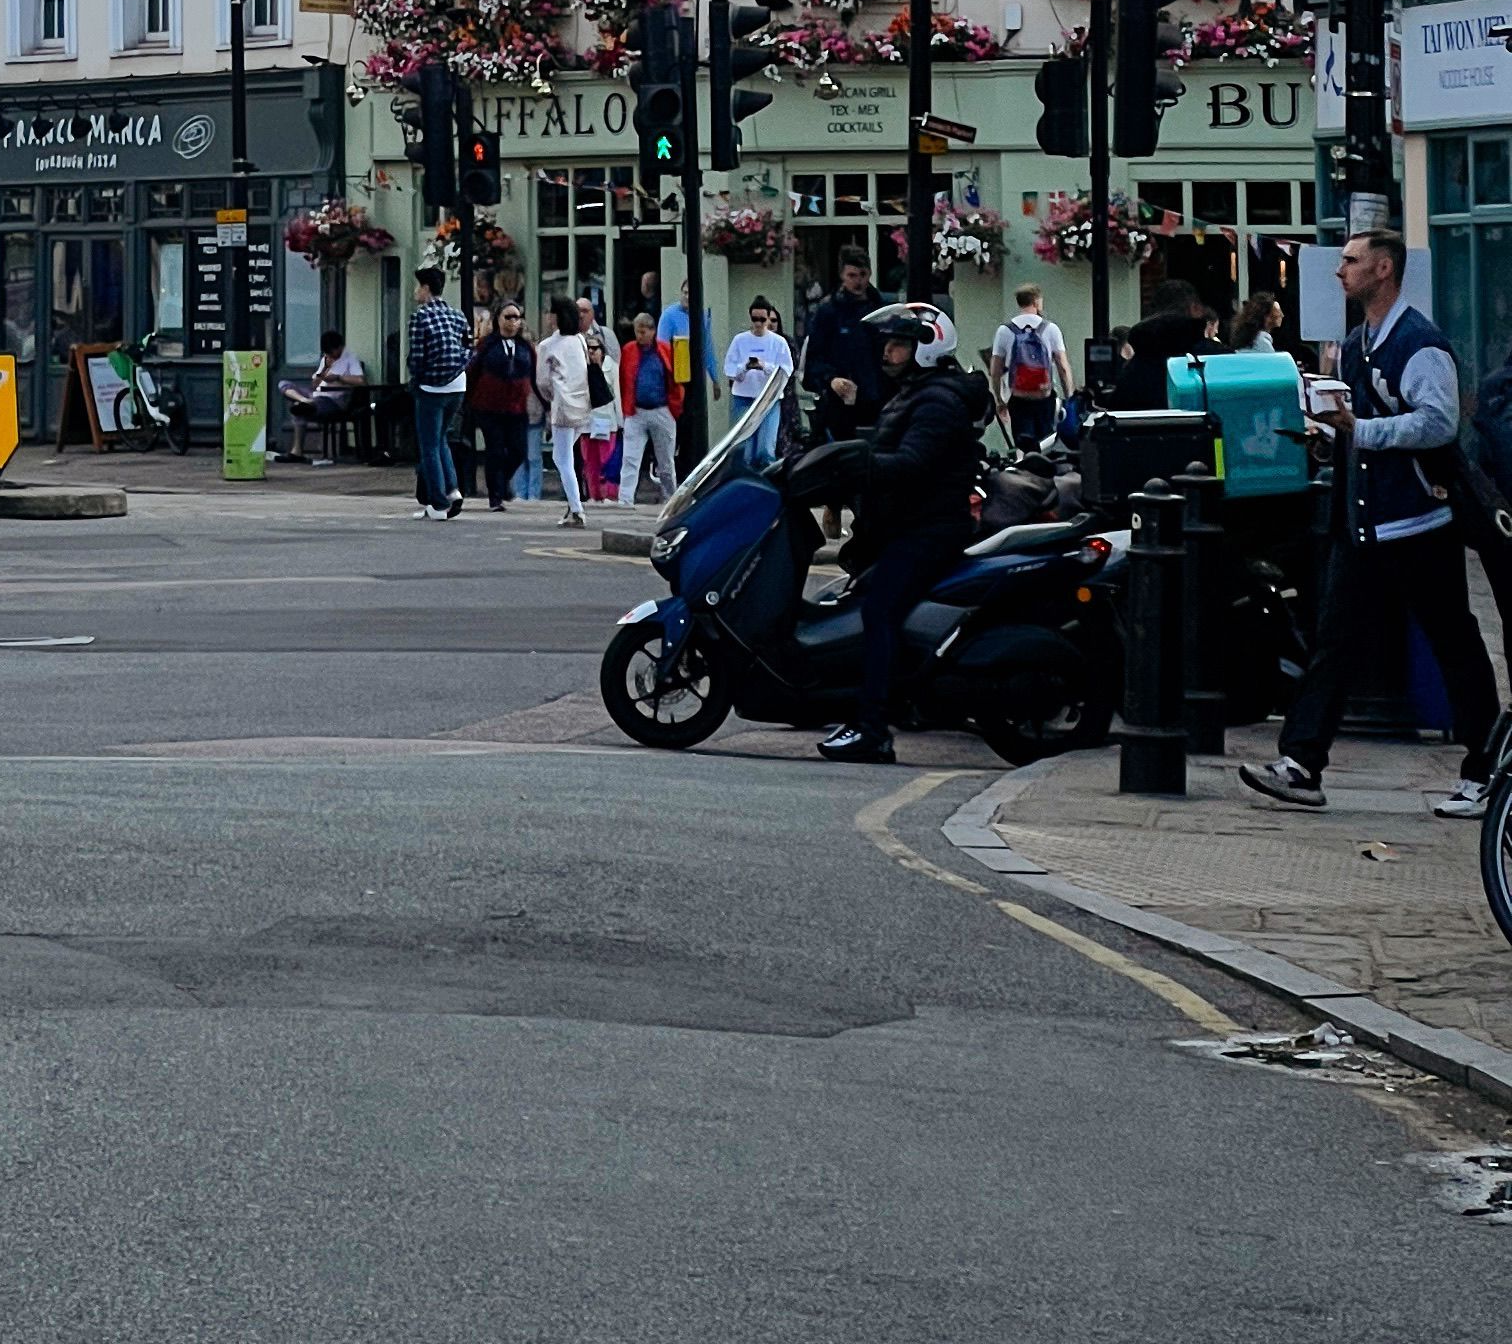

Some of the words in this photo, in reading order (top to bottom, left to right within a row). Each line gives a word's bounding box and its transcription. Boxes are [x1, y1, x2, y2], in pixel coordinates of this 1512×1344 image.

[869, 86, 897, 98] GRILL
[830, 104, 849, 116] TEX
[857, 104, 880, 116] MEX
[827, 122, 884, 134] COCKTAILS
